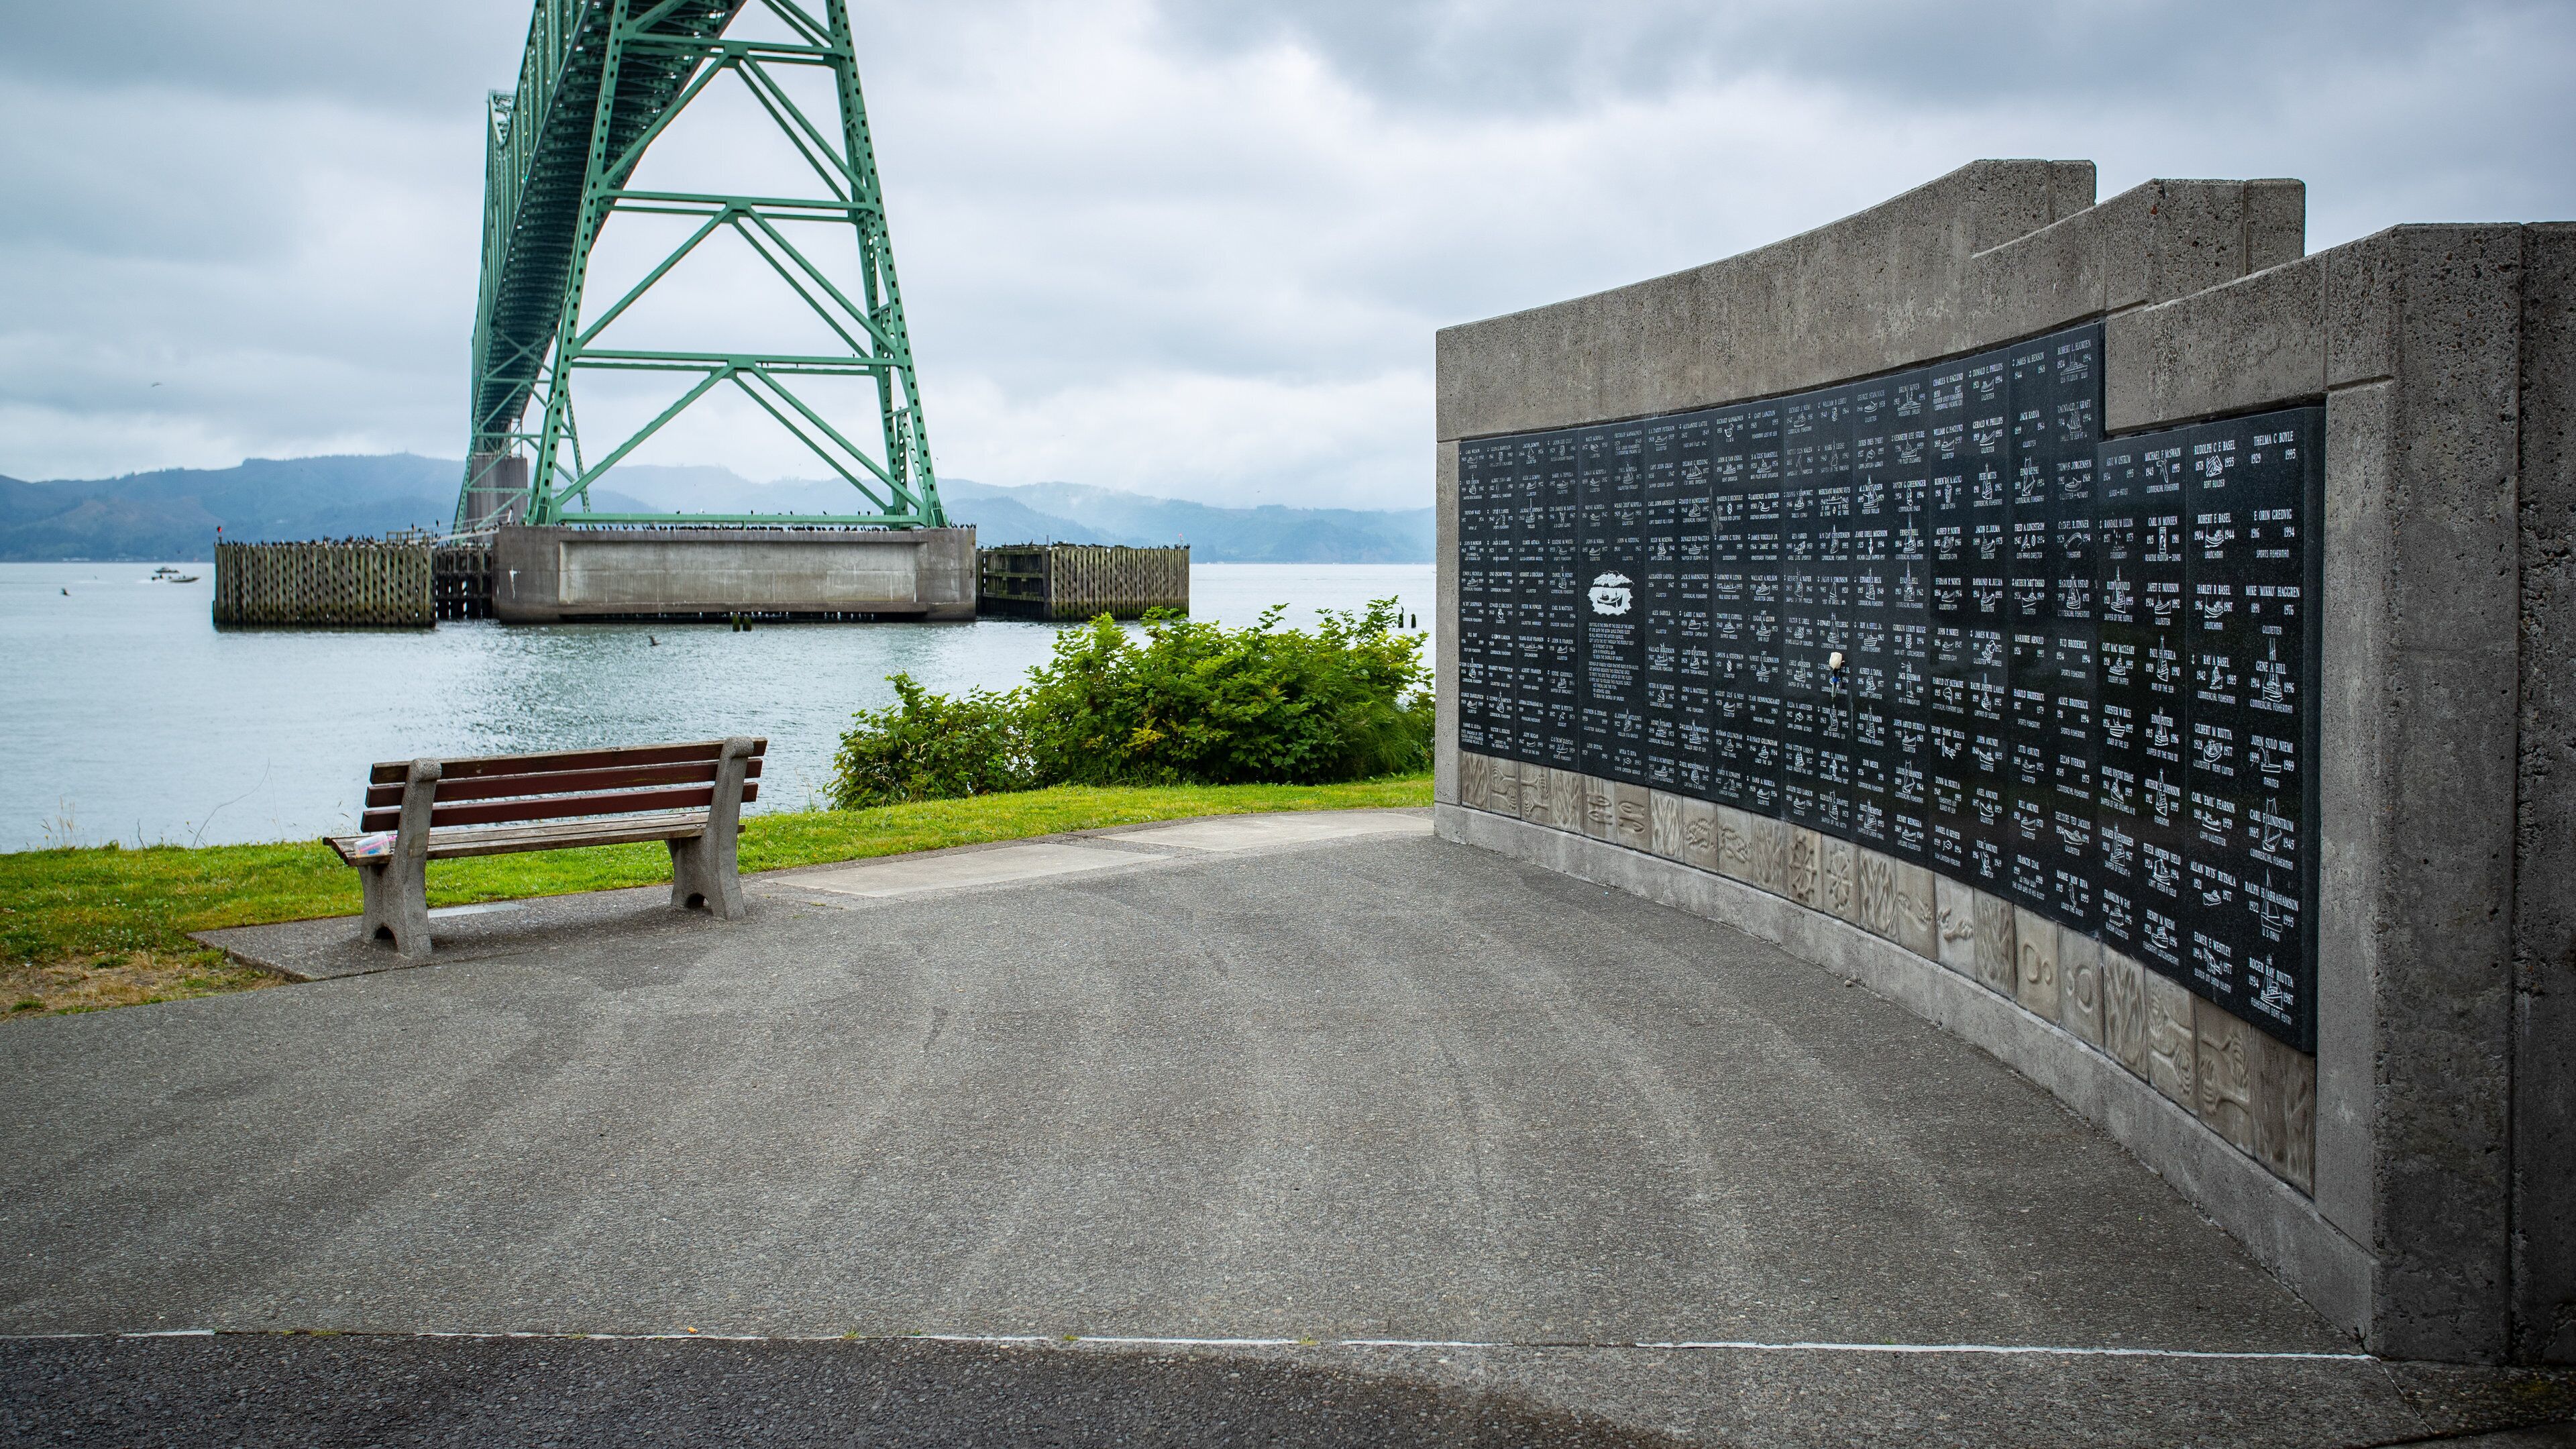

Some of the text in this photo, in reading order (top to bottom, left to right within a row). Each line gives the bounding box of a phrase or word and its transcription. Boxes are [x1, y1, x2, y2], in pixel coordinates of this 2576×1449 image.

[2254, 434, 2271, 446] THELMA
[2279, 431, 2294, 443] BOYLE
[2194, 440, 2235, 455] RUDOLPH BASEL
[2198, 513, 2231, 524] ROBERT BASEL
[2259, 510, 2269, 520] ORIN
[2272, 508, 2292, 520] GREDVIG
[2256, 549, 2268, 558] SPORTS
[2197, 584, 2231, 595] HARLEY BASEL
[2246, 586, 2257, 596] MIKE
[2217, 656, 2229, 667] BASEL
[2256, 661, 2268, 672] GENE
[2275, 663, 2286, 674] HILL
[2194, 723, 2210, 735] GILBERT
[2251, 735, 2293, 753] JOHN SULO NIEMI
[2192, 792, 2202, 804] CARL
[2216, 799, 2235, 814] PEARSON
[2249, 809, 2261, 822] CARL
[2245, 881, 2298, 911] RALPH ABRAHAMSON
[2194, 931, 2231, 957] ELMER WESTLEY
[2249, 957, 2294, 987] ROGER RAY RIUTTA
